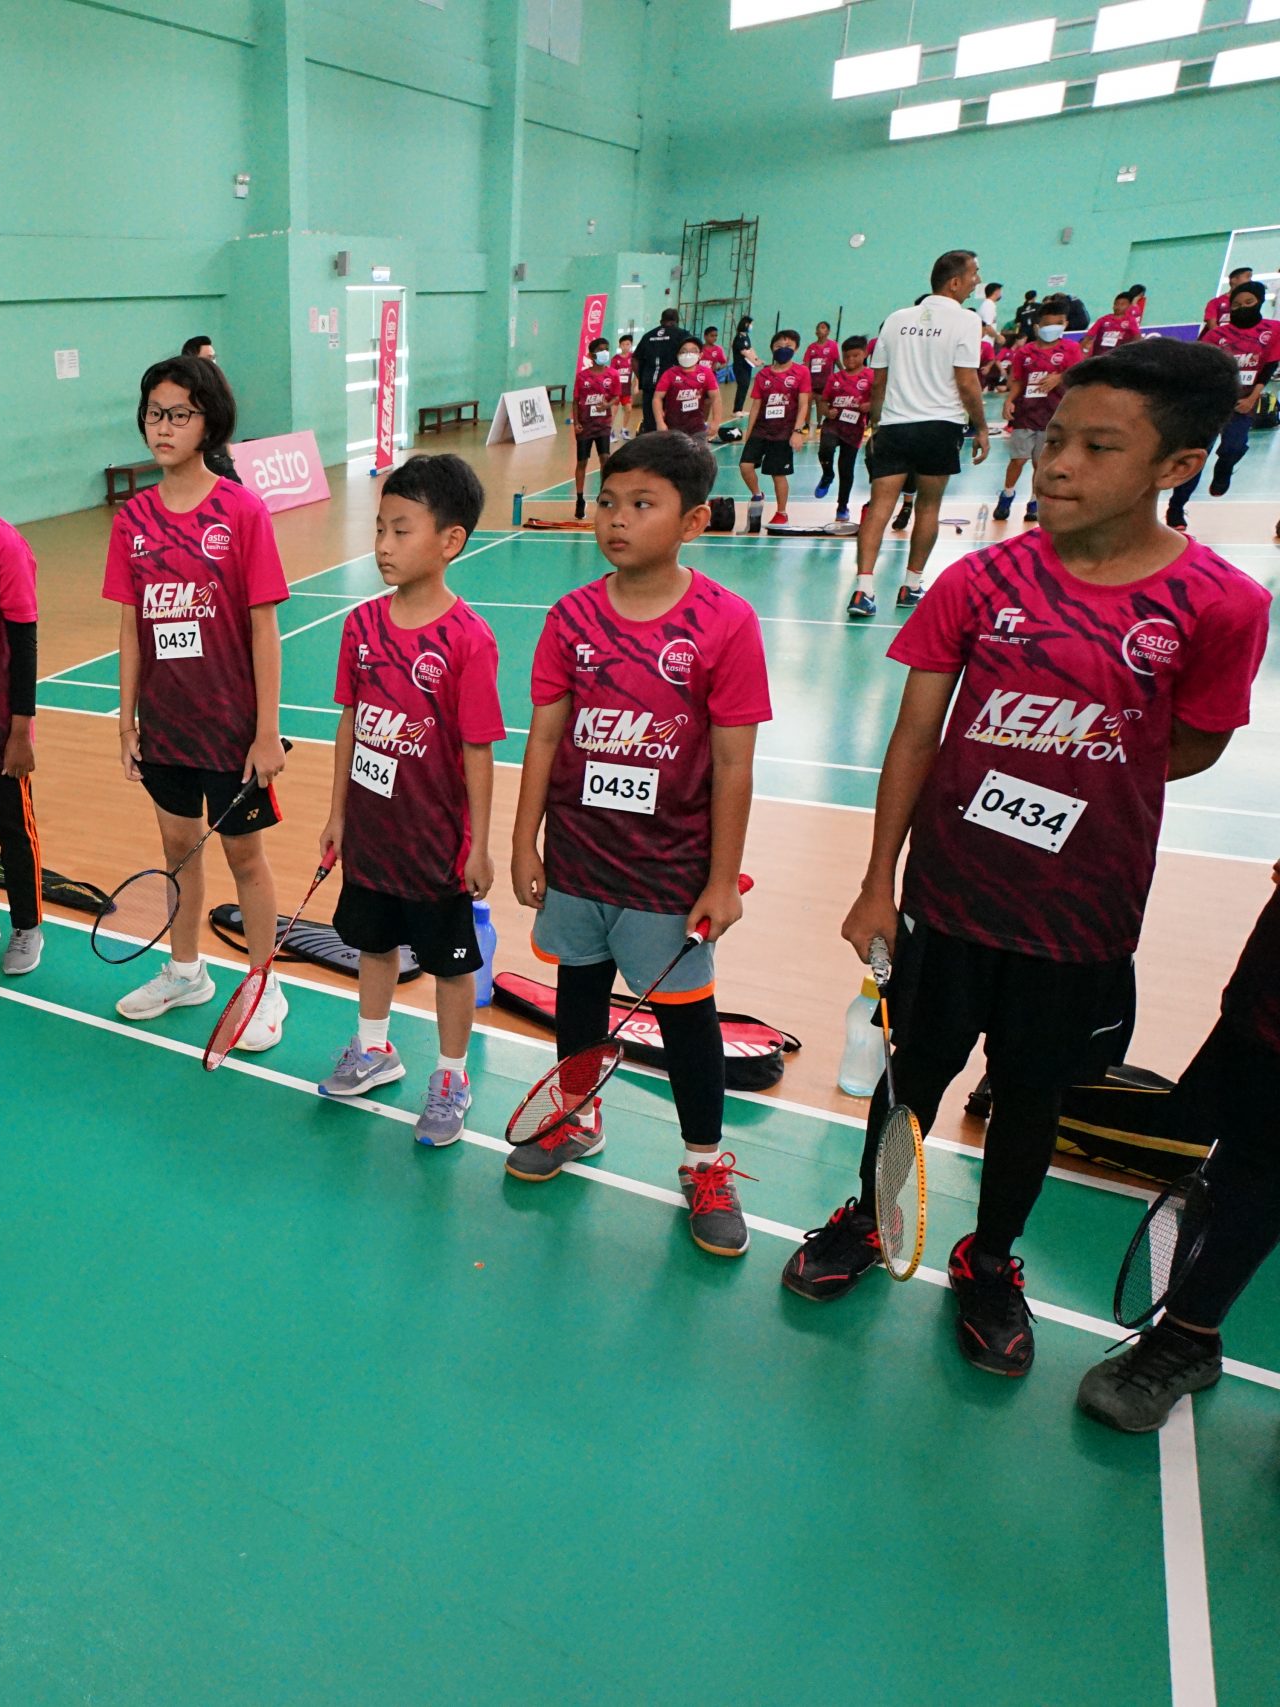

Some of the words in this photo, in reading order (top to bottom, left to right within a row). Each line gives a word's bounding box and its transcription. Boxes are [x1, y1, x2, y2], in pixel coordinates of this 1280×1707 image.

[900, 326, 942, 337] COACH
[251, 448, 310, 490] astro
[207, 533, 230, 543] astro
[143, 582, 196, 608] KEM
[142, 605, 217, 619] BADMINTON
[158, 631, 197, 650] 0437
[978, 634, 1032, 645] FELET
[1136, 632, 1180, 651] astro
[419, 662, 443, 676] astro
[355, 700, 408, 739] KEM
[574, 707, 654, 742] KEM
[975, 688, 1106, 740] KEM
[354, 755, 390, 786] 0436
[589, 774, 651, 801] 0435
[980, 788, 1069, 836] 0434
